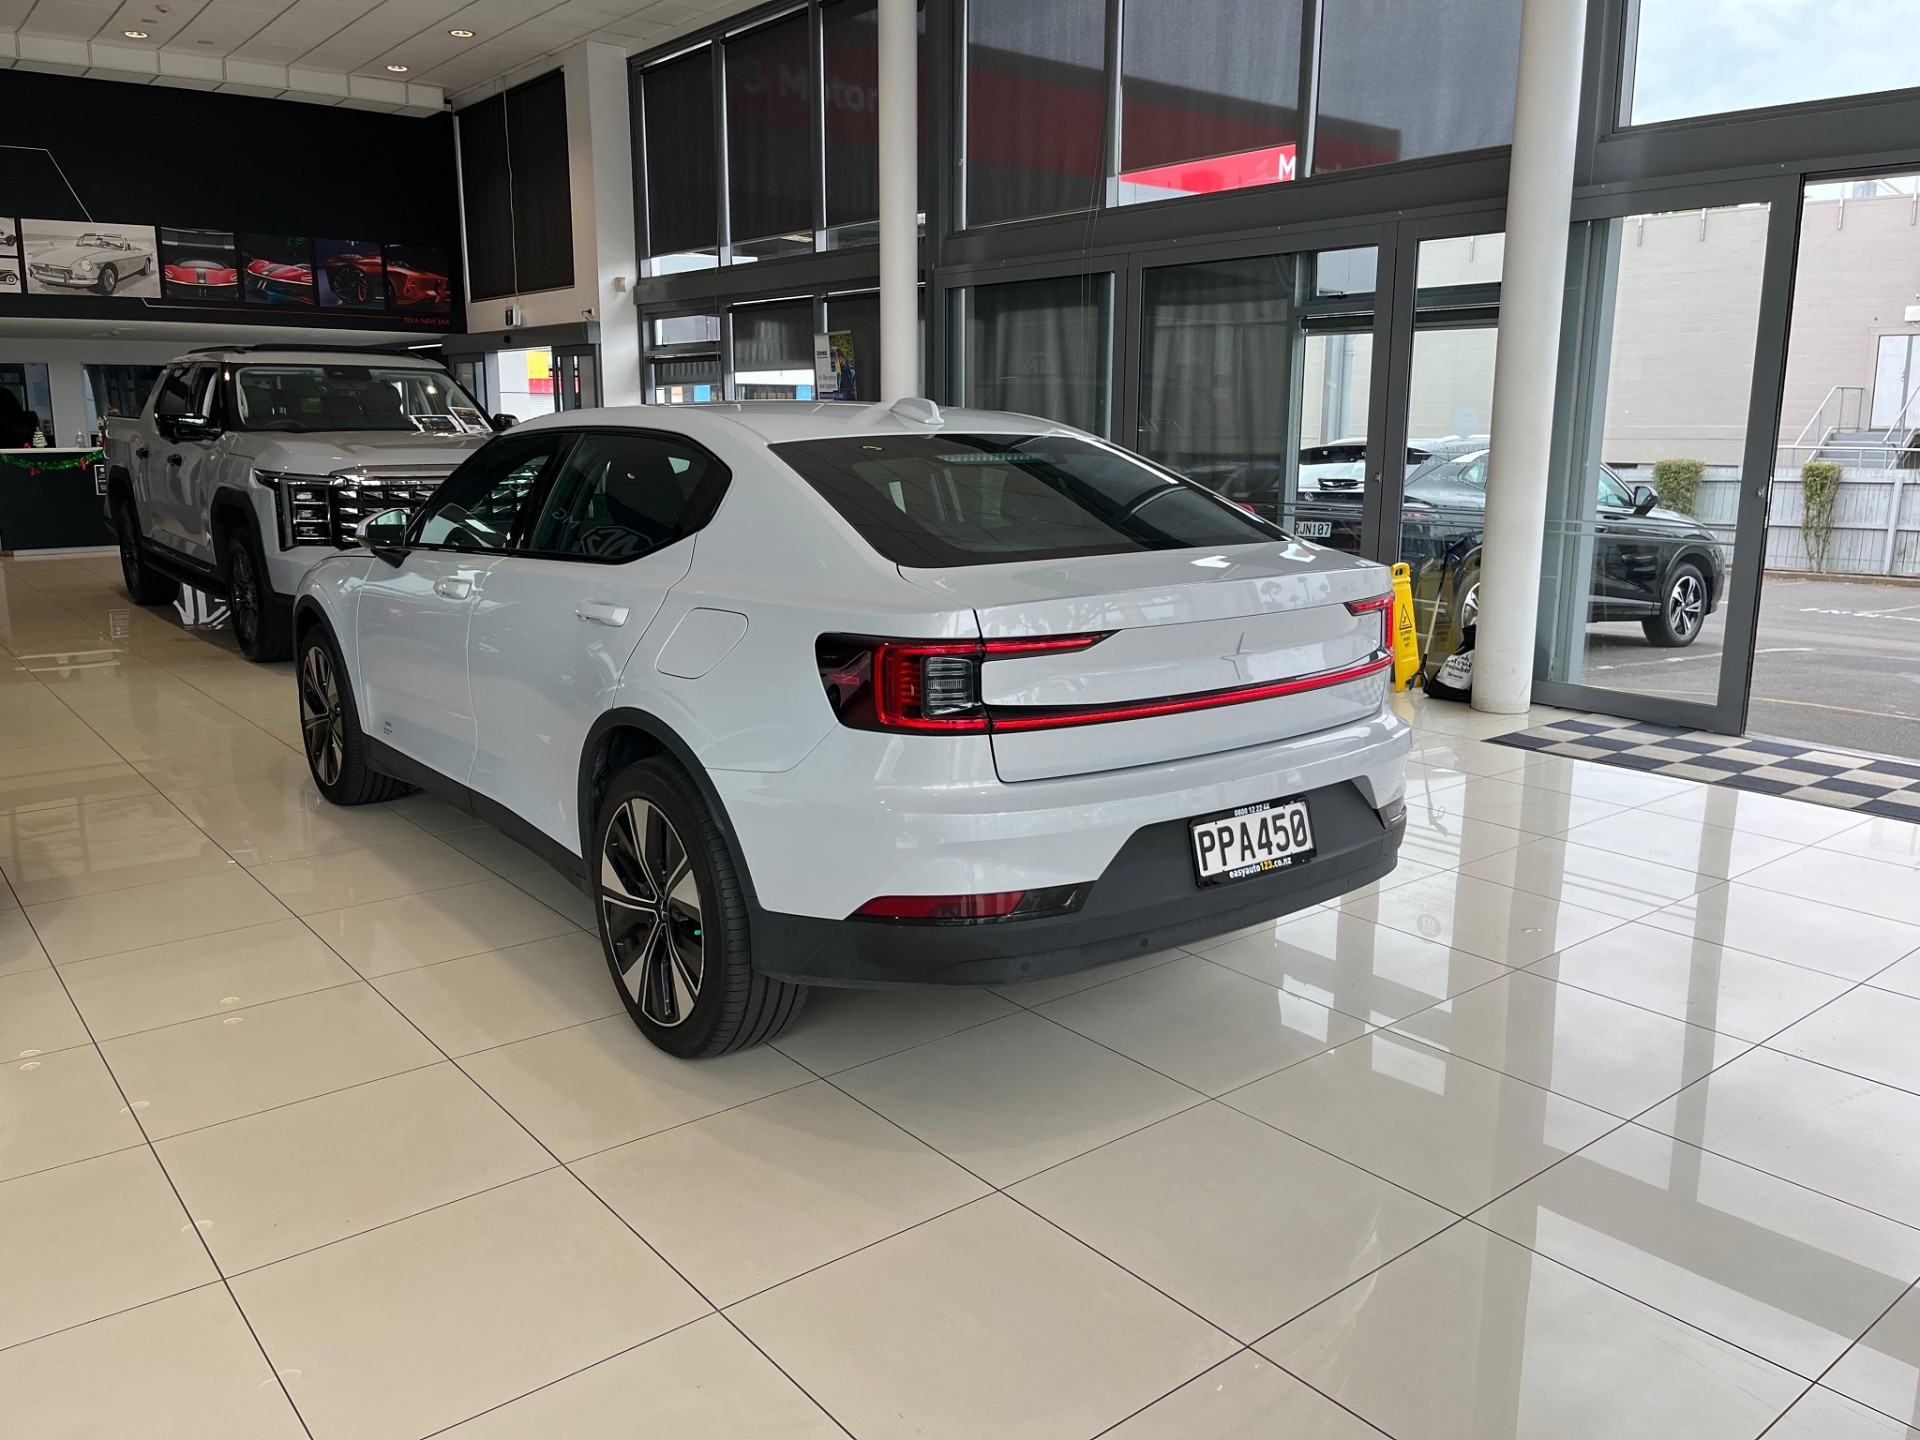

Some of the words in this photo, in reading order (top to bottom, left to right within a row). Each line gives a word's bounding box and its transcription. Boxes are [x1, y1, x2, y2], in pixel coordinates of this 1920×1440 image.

[1295, 523, 1330, 535] RJN107
[1234, 807, 1247, 816] 0800
[1248, 805, 1256, 814] 12
[1256, 804, 1263, 813] 22
[1197, 808, 1308, 871] PPA450
[1229, 856, 1292, 879] easyauto123.co.nz
